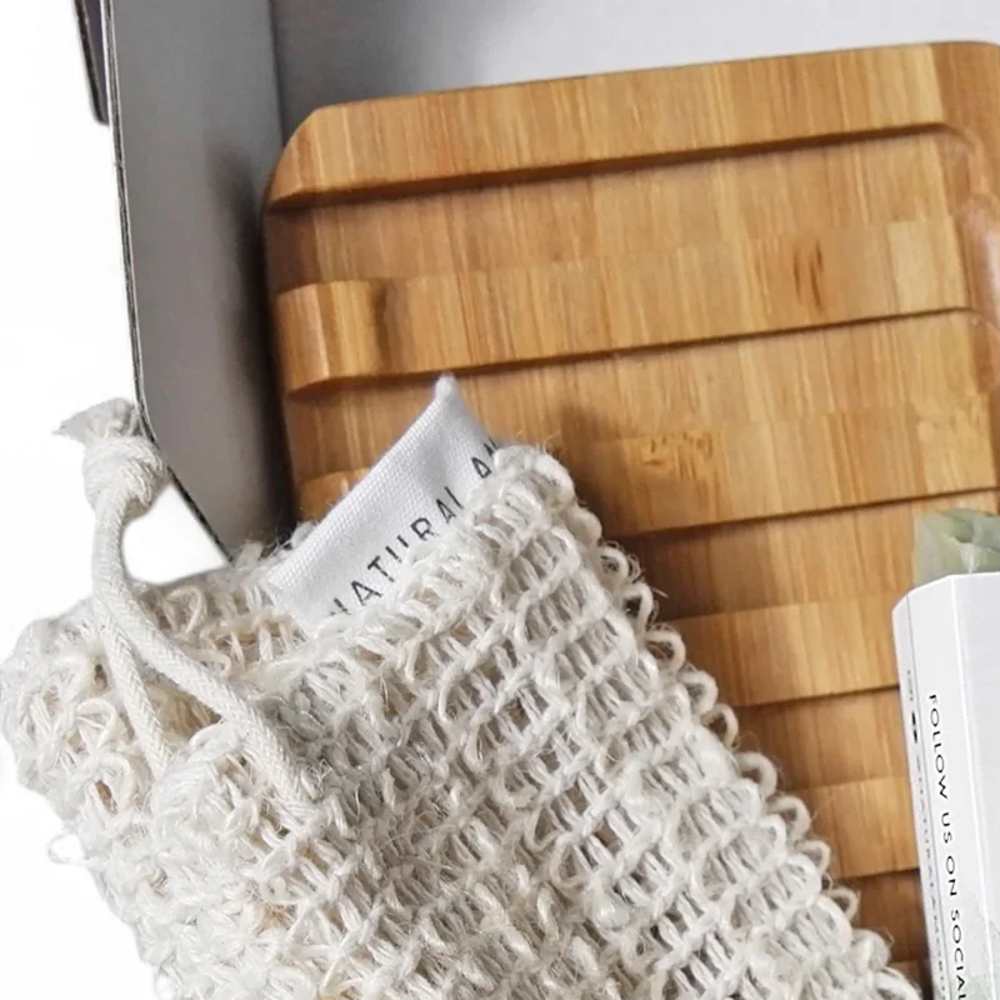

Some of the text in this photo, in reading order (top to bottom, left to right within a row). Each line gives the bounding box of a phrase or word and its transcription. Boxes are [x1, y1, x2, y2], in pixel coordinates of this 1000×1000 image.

[928, 694, 948, 800] FOLLOW
[941, 811, 953, 844] US
[945, 855, 958, 897] ON
